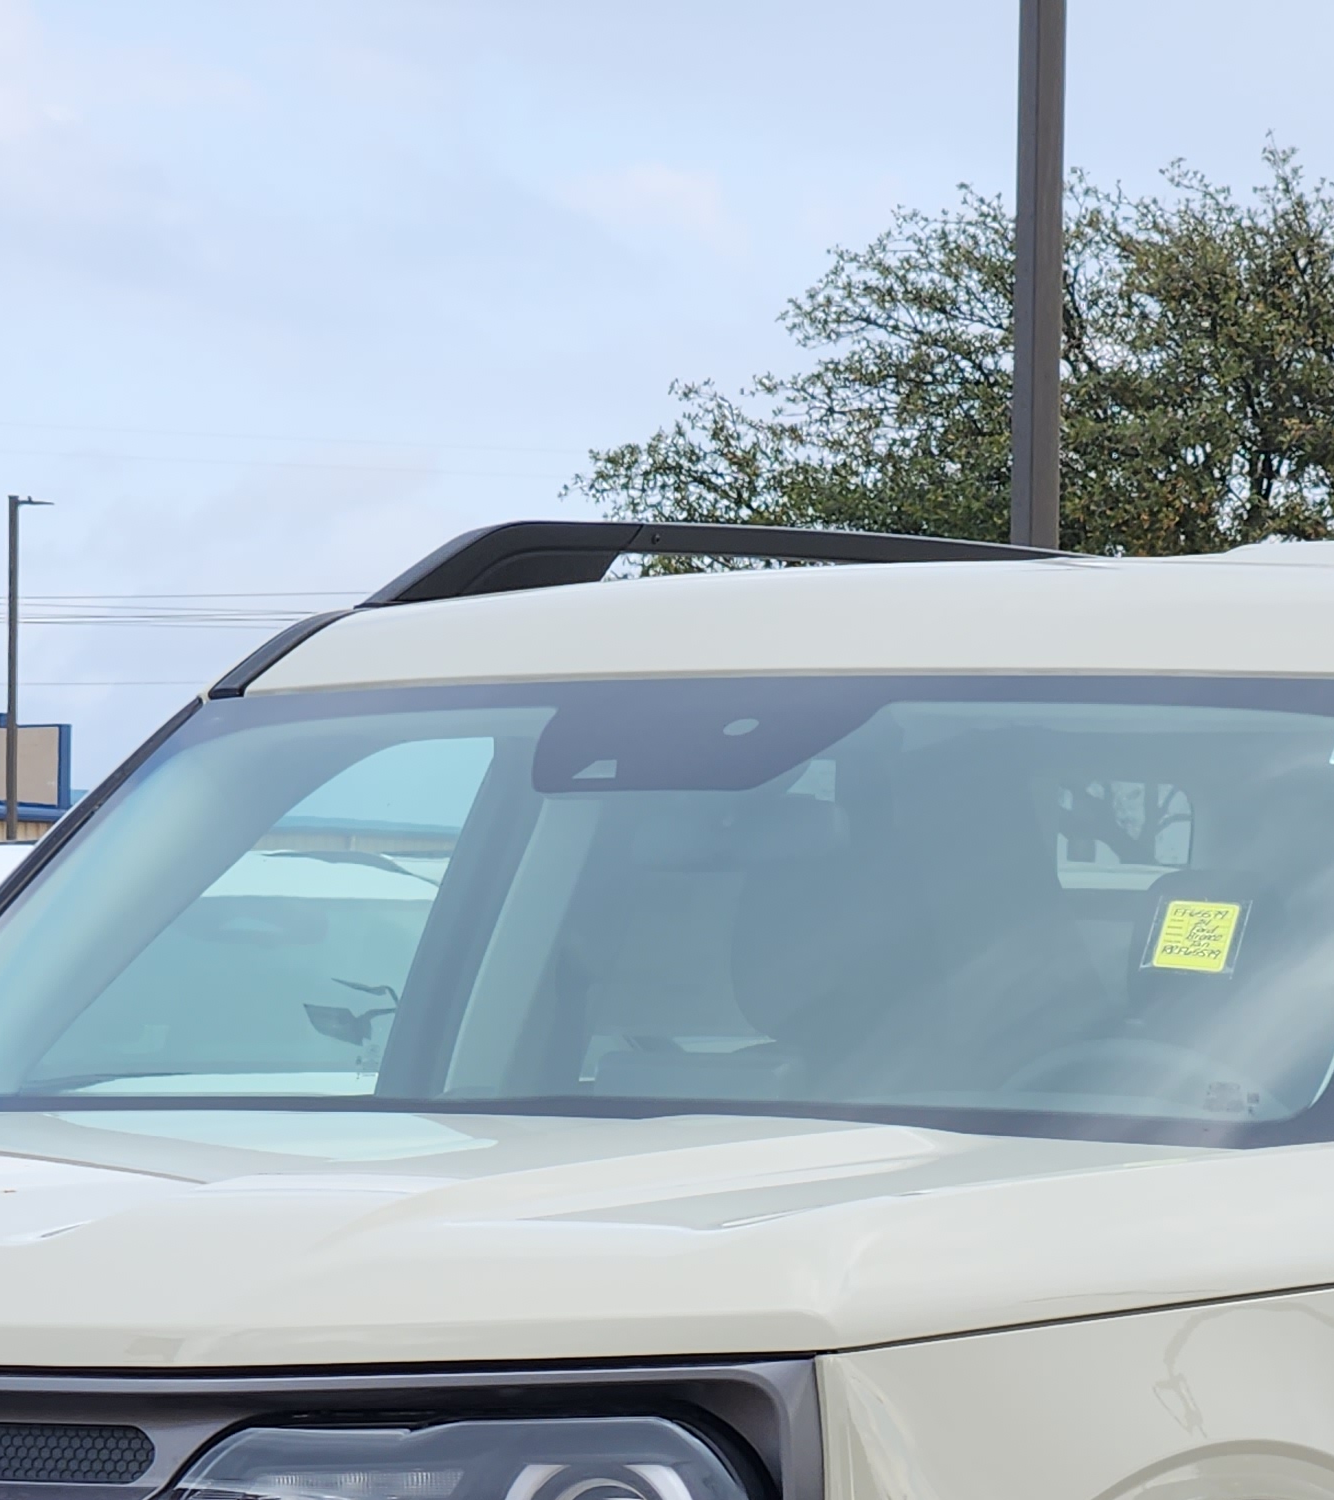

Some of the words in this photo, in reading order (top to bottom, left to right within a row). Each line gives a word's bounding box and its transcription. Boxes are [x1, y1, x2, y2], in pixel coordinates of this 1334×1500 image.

[1190, 925, 1220, 934] Ford
[1186, 932, 1223, 941] Bronco
[1190, 940, 1210, 948] Tan
